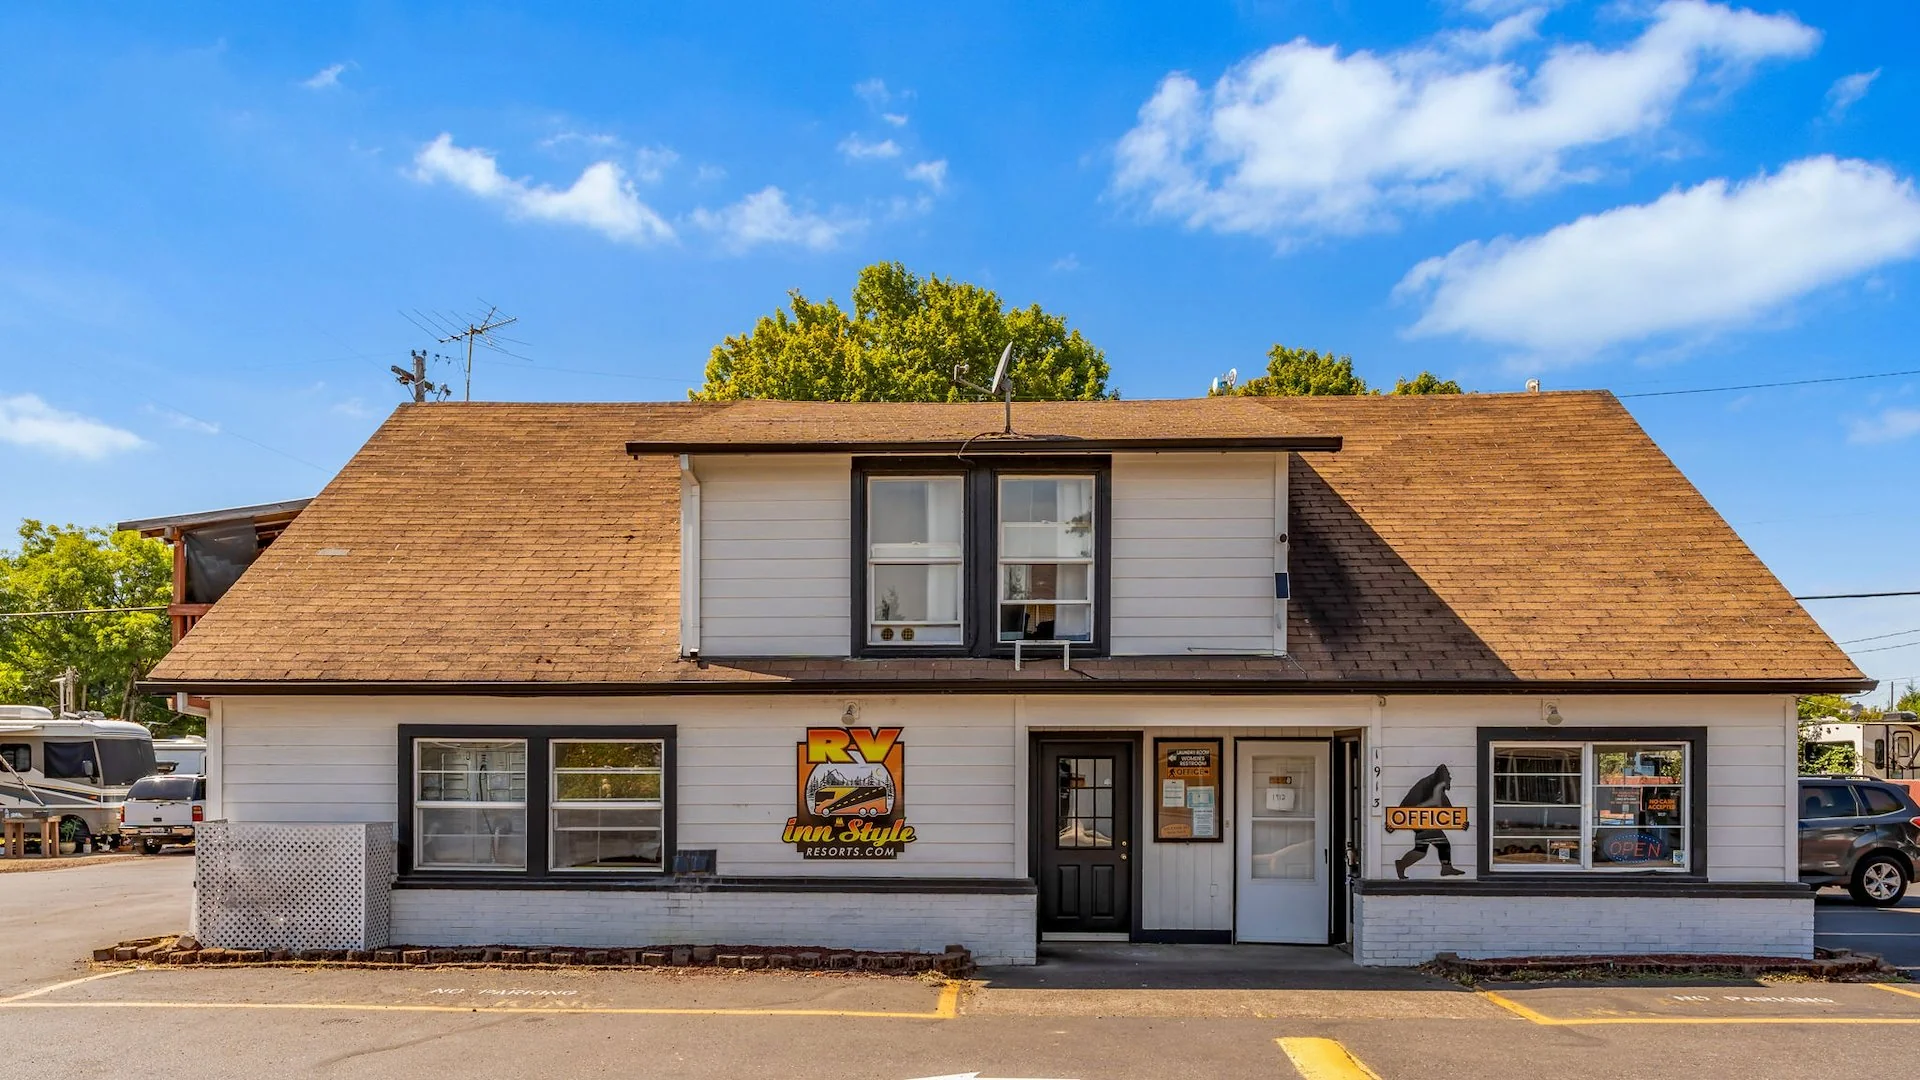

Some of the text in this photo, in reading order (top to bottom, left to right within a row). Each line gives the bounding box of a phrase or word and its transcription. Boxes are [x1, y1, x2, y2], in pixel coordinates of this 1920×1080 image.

[807, 727, 904, 763] RV
[1176, 768, 1204, 776] OFFICE
[1372, 749, 1381, 808] 1913
[1391, 810, 1462, 826] OFFICE
[839, 817, 917, 847] Style
[806, 847, 895, 857] RESORTS.COM
[1609, 841, 1661, 858] OPEN
[478, 988, 578, 996] PARKING
[1723, 995, 1835, 1003] PARKING
